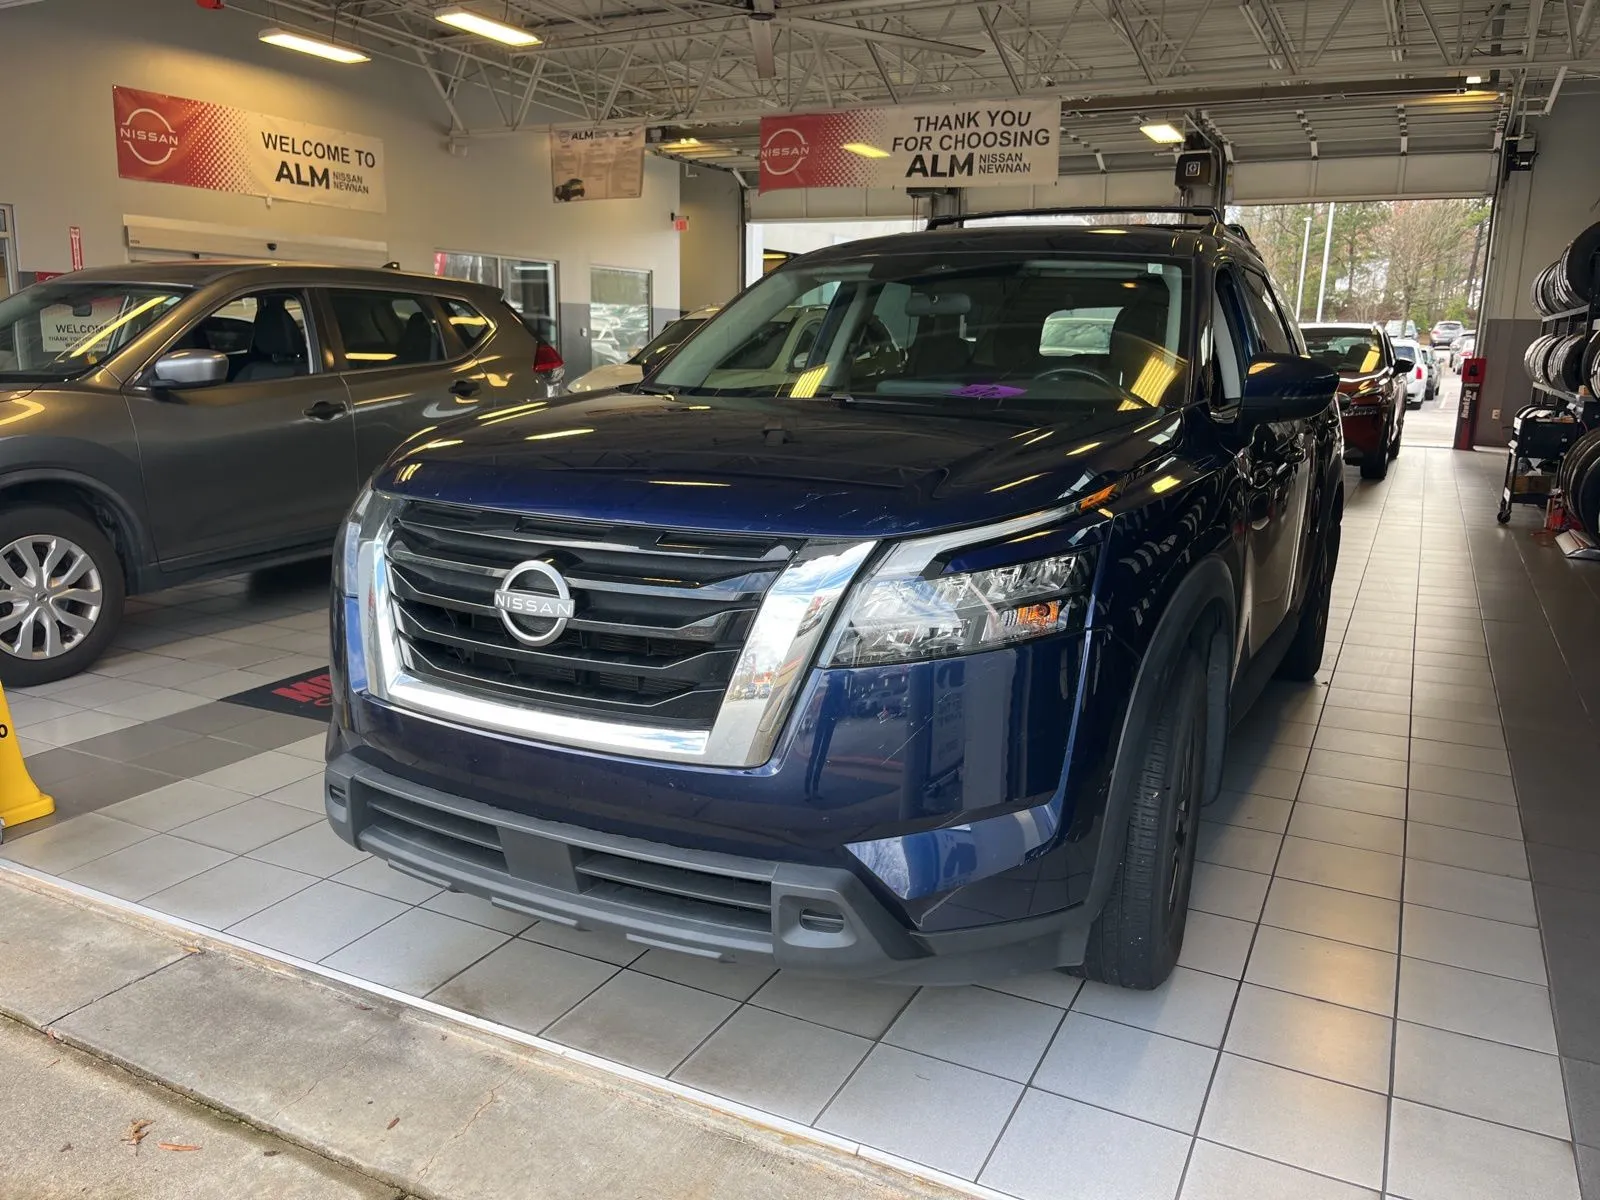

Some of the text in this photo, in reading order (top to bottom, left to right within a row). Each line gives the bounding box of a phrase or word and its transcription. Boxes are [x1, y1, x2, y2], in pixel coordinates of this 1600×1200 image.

[914, 110, 1032, 133] THANK YOU
[120, 127, 178, 146] NISSAN
[571, 131, 594, 140] ALM
[892, 128, 1050, 153] FOR CHOOSING
[261, 131, 376, 168] WELCOME TO
[760, 146, 809, 158] NISSAN
[978, 153, 1023, 164] NISSAN
[905, 152, 975, 178] ALM
[978, 163, 1031, 175] NEWNAN
[275, 160, 330, 190] ALM
[332, 171, 363, 184] NISSAN
[333, 181, 369, 195] NEWNAN
[495, 593, 571, 616] NISSAN
